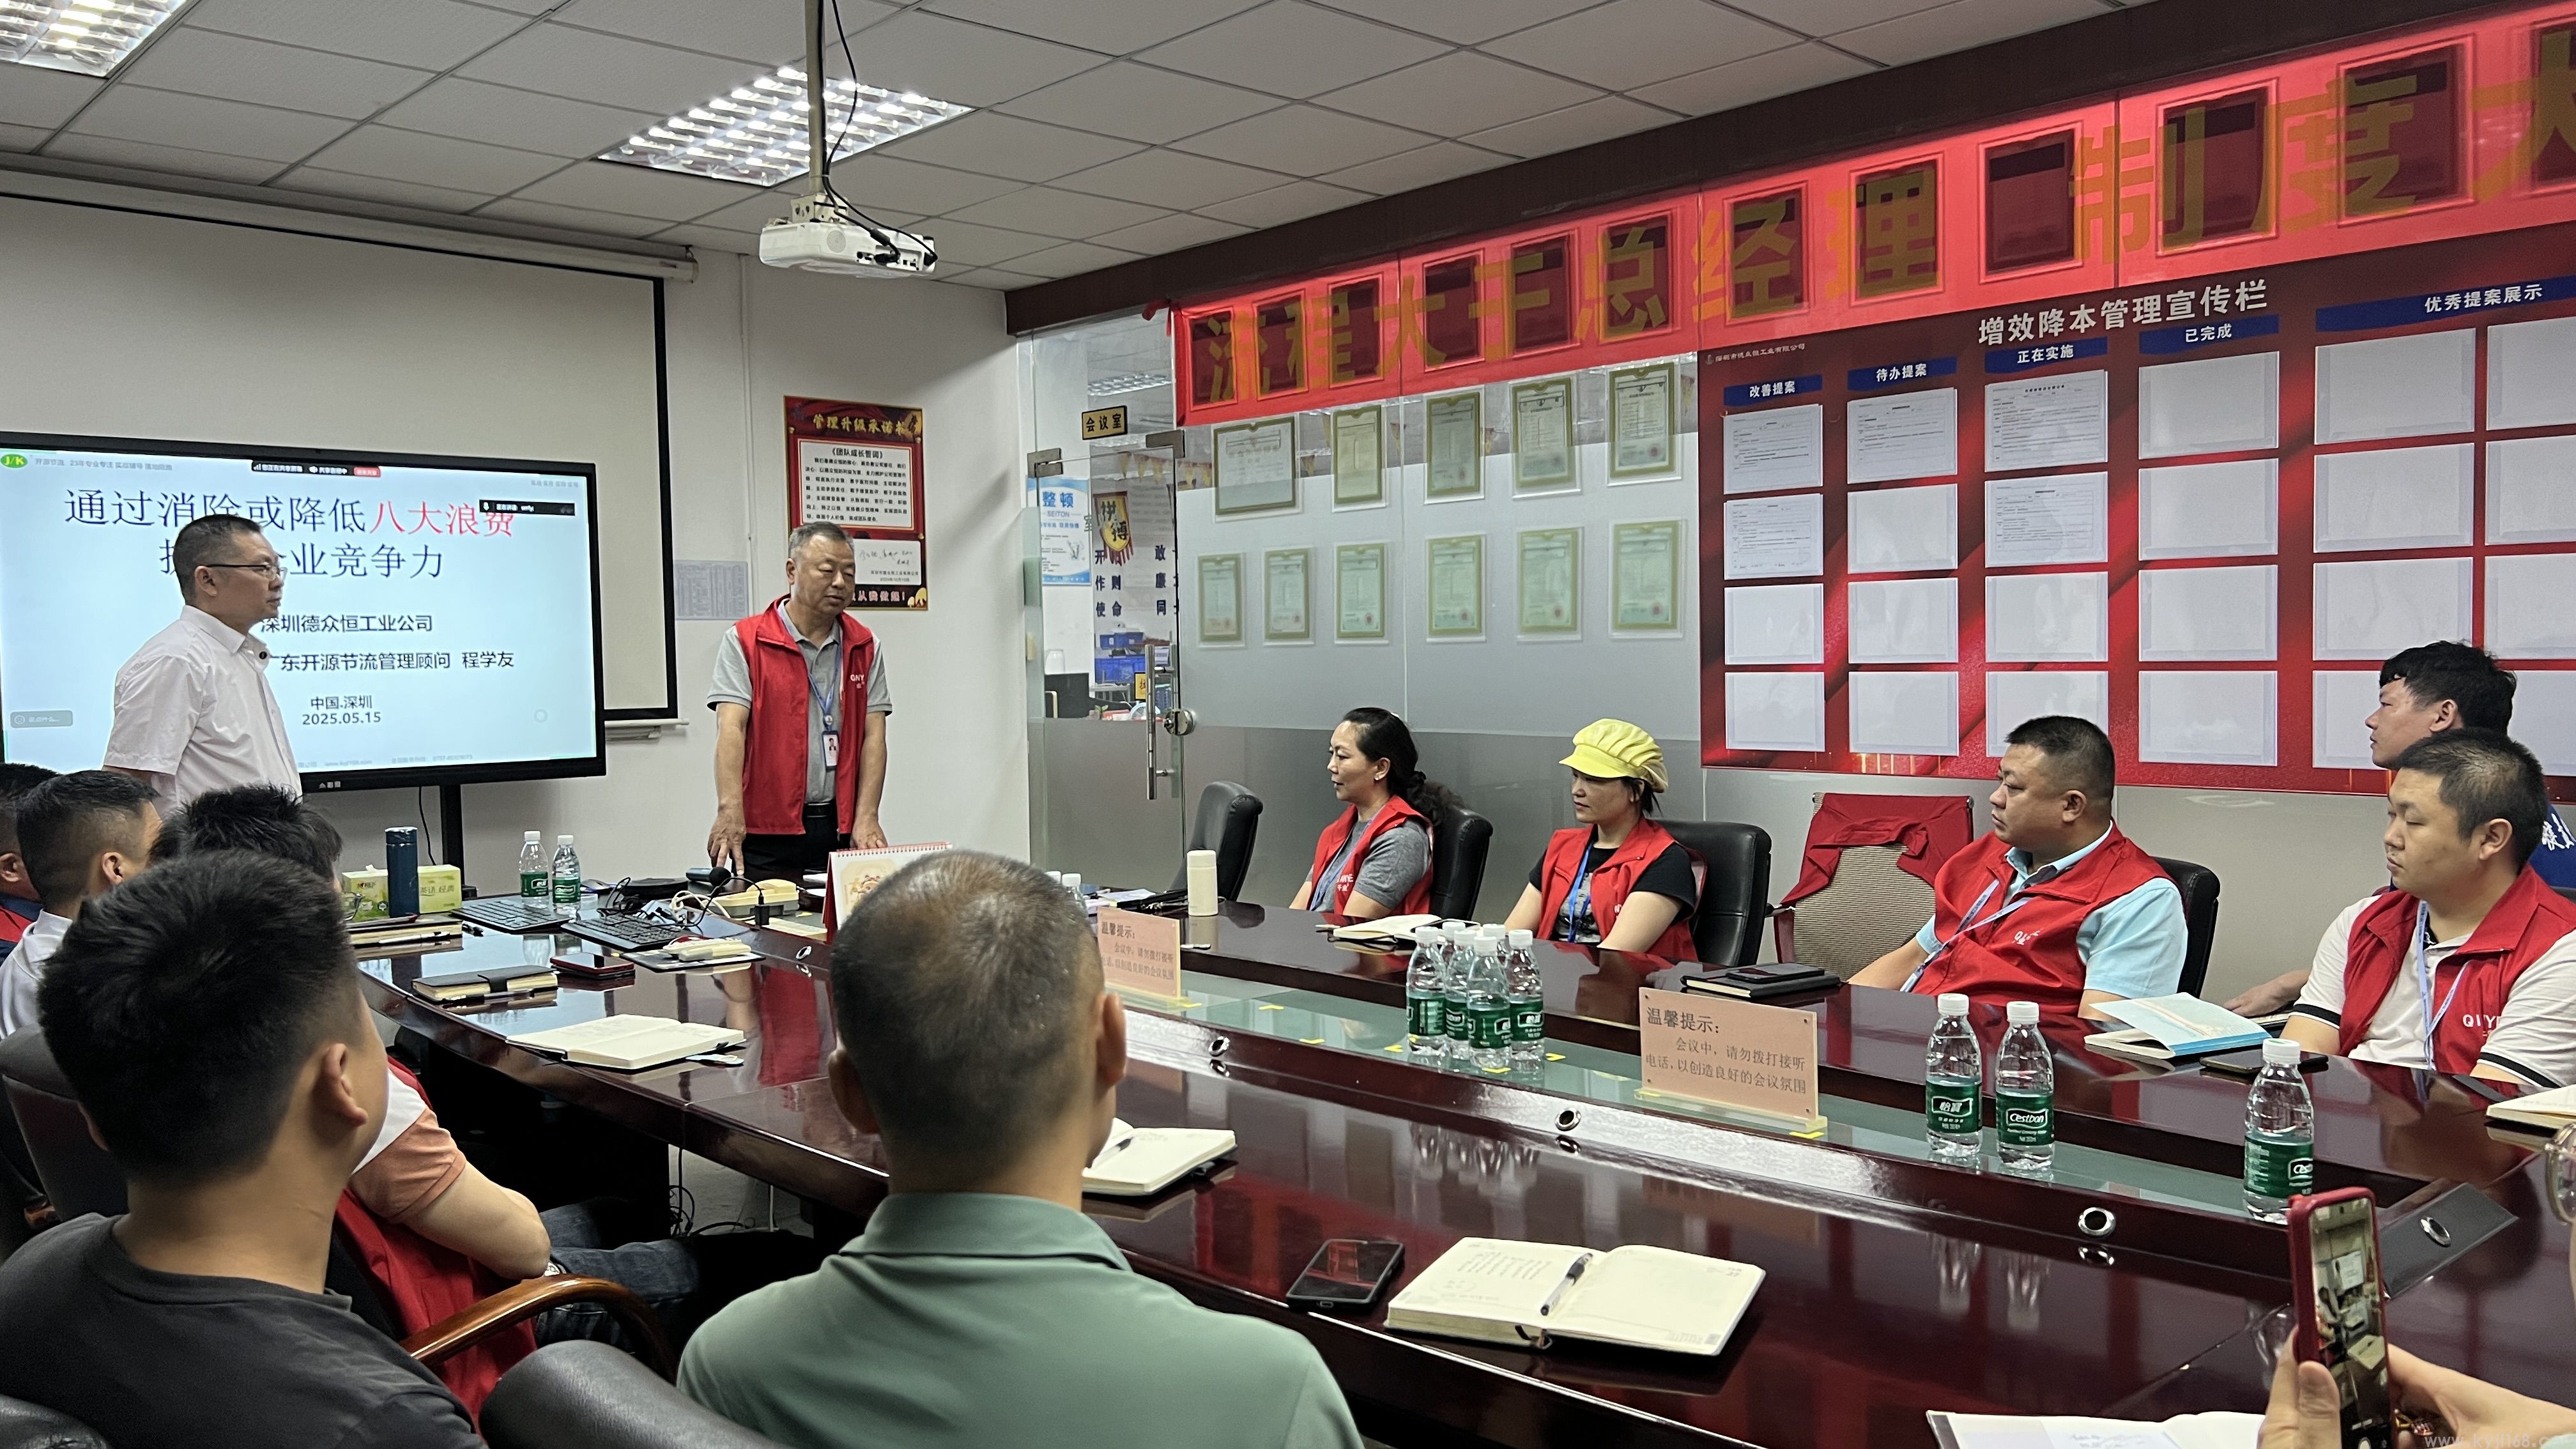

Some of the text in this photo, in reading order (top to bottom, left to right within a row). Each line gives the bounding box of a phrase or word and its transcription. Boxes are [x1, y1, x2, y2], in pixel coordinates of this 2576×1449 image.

[2425, 284, 2543, 314] 优秀提案展示
[1978, 279, 2267, 346] 增效降本管理宣传栏
[2185, 324, 2232, 343] 已完成
[2017, 344, 2074, 364] 正在实施
[1876, 363, 1928, 383] 待办提案
[1749, 380, 1796, 398] 改善提案
[813, 413, 905, 436] 管理升级承诺书
[1085, 413, 1122, 433] 会议室
[1042, 491, 1074, 509] 整顿
[1100, 500, 1129, 541] 拼搏
[1095, 574, 1122, 592] 作则
[852, 590, 905, 602] 从我做起！
[1096, 601, 1123, 618] 使命
[261, 615, 433, 633] 深圳德众恒工业公司
[461, 650, 514, 669] 程学友
[310, 695, 372, 710] 中国.深圳
[302, 712, 381, 726] 2025.05.15
[1646, 1006, 1719, 1034] 温馨提示：
[1675, 1036, 1805, 1072] 会议中，请勿拨打接听
[1646, 1053, 1806, 1095] 电话，以创造良好的会议氛围
